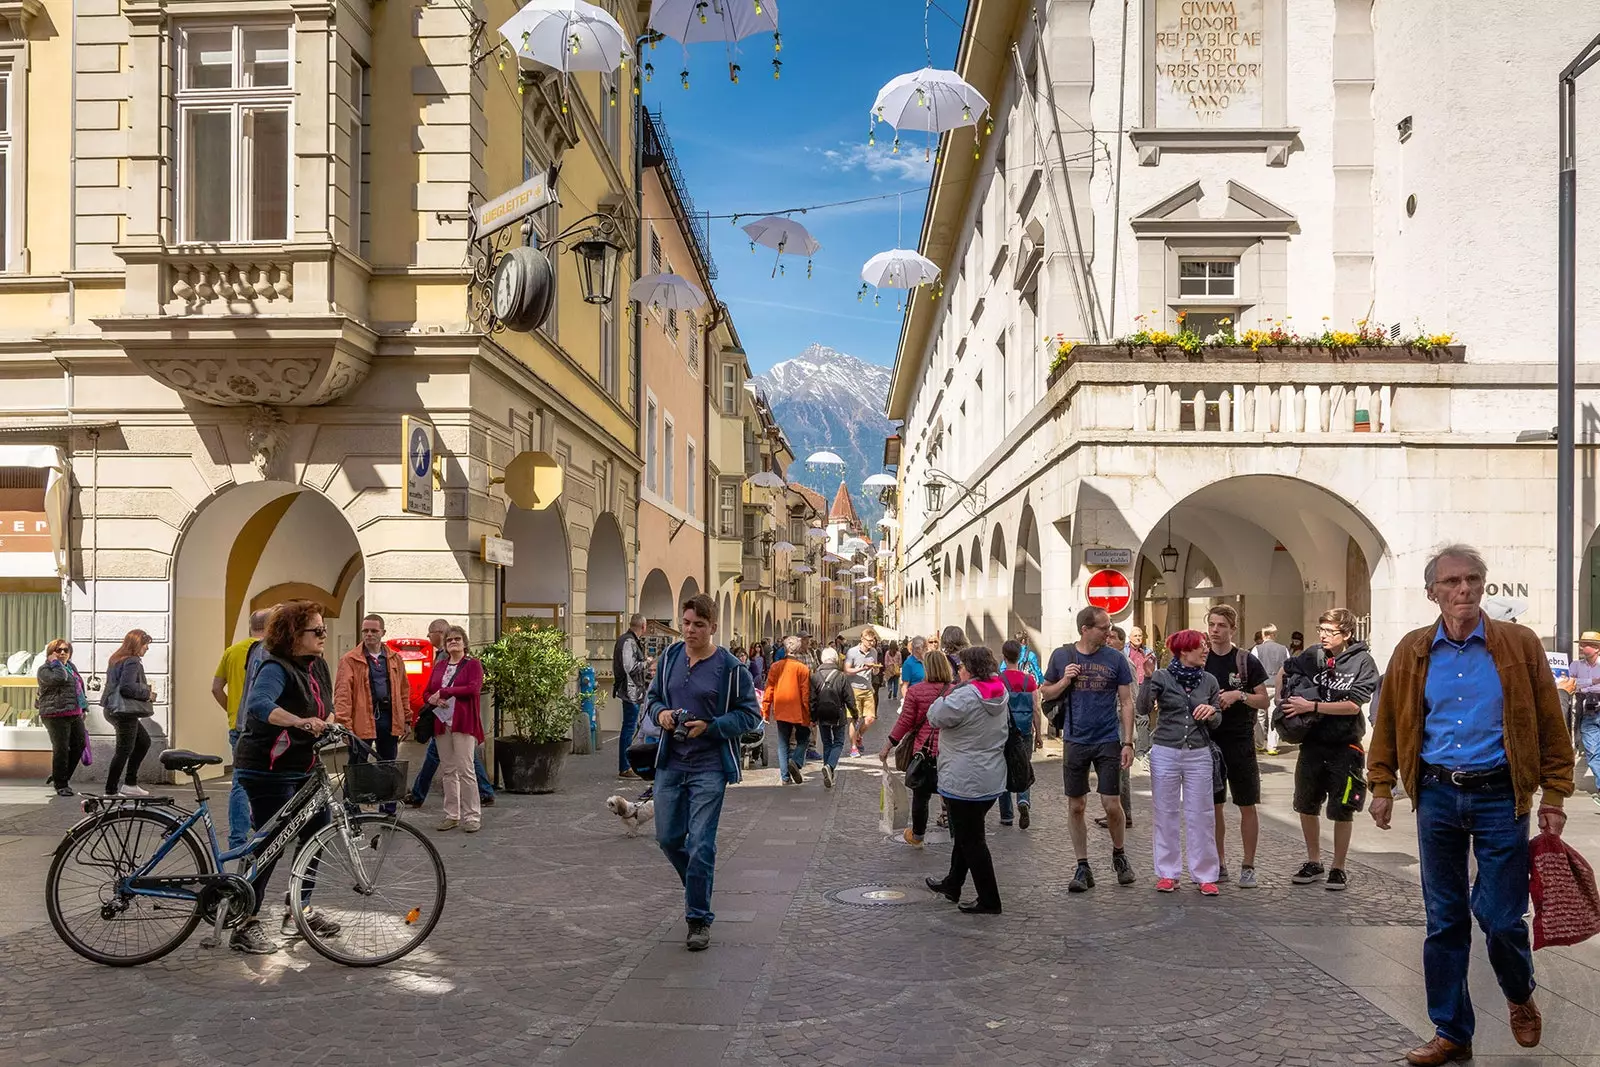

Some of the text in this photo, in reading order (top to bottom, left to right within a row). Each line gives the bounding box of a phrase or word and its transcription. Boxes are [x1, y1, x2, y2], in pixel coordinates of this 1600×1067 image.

[1180, 17, 1238, 31] HONORI
[1181, 48, 1237, 62] LABORI
[1171, 79, 1246, 94] MCMXXIX
[1188, 95, 1230, 109] ANNO
[1549, 656, 1568, 666] ebra.
